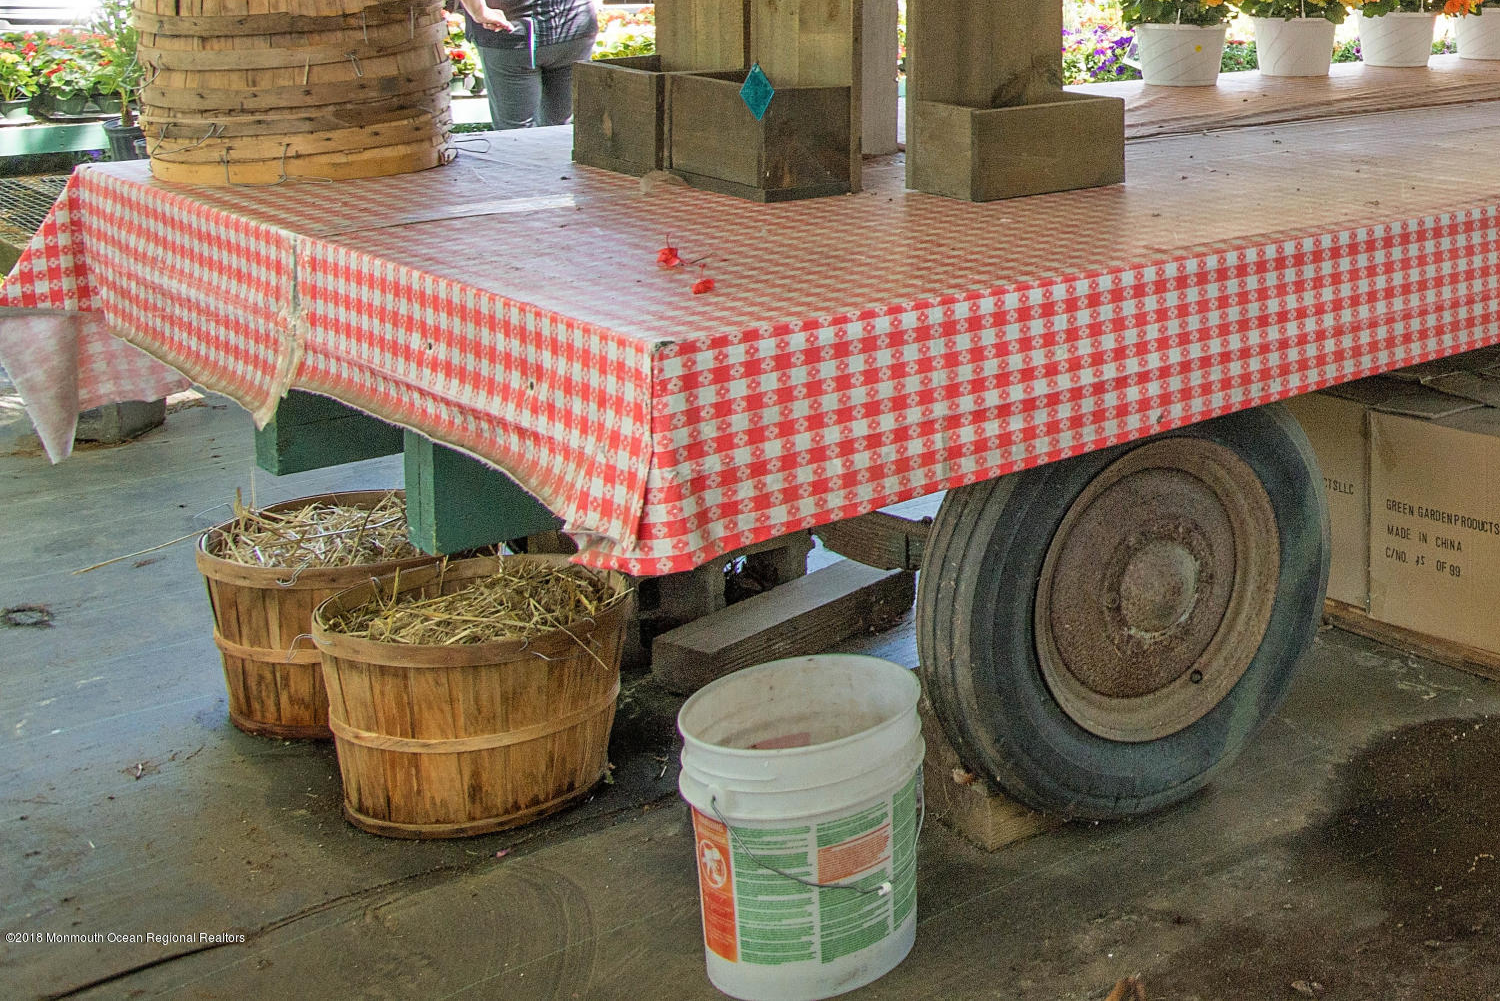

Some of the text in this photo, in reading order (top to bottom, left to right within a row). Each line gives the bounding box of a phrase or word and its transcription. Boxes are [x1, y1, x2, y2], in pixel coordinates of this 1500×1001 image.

[1386, 498, 1414, 517] GREEN
[1387, 523, 1463, 552] MADE IN CHINA
[1385, 546, 1409, 564] C/NO.
[1436, 559, 1447, 573] OF
[1450, 566, 1461, 578] 99
